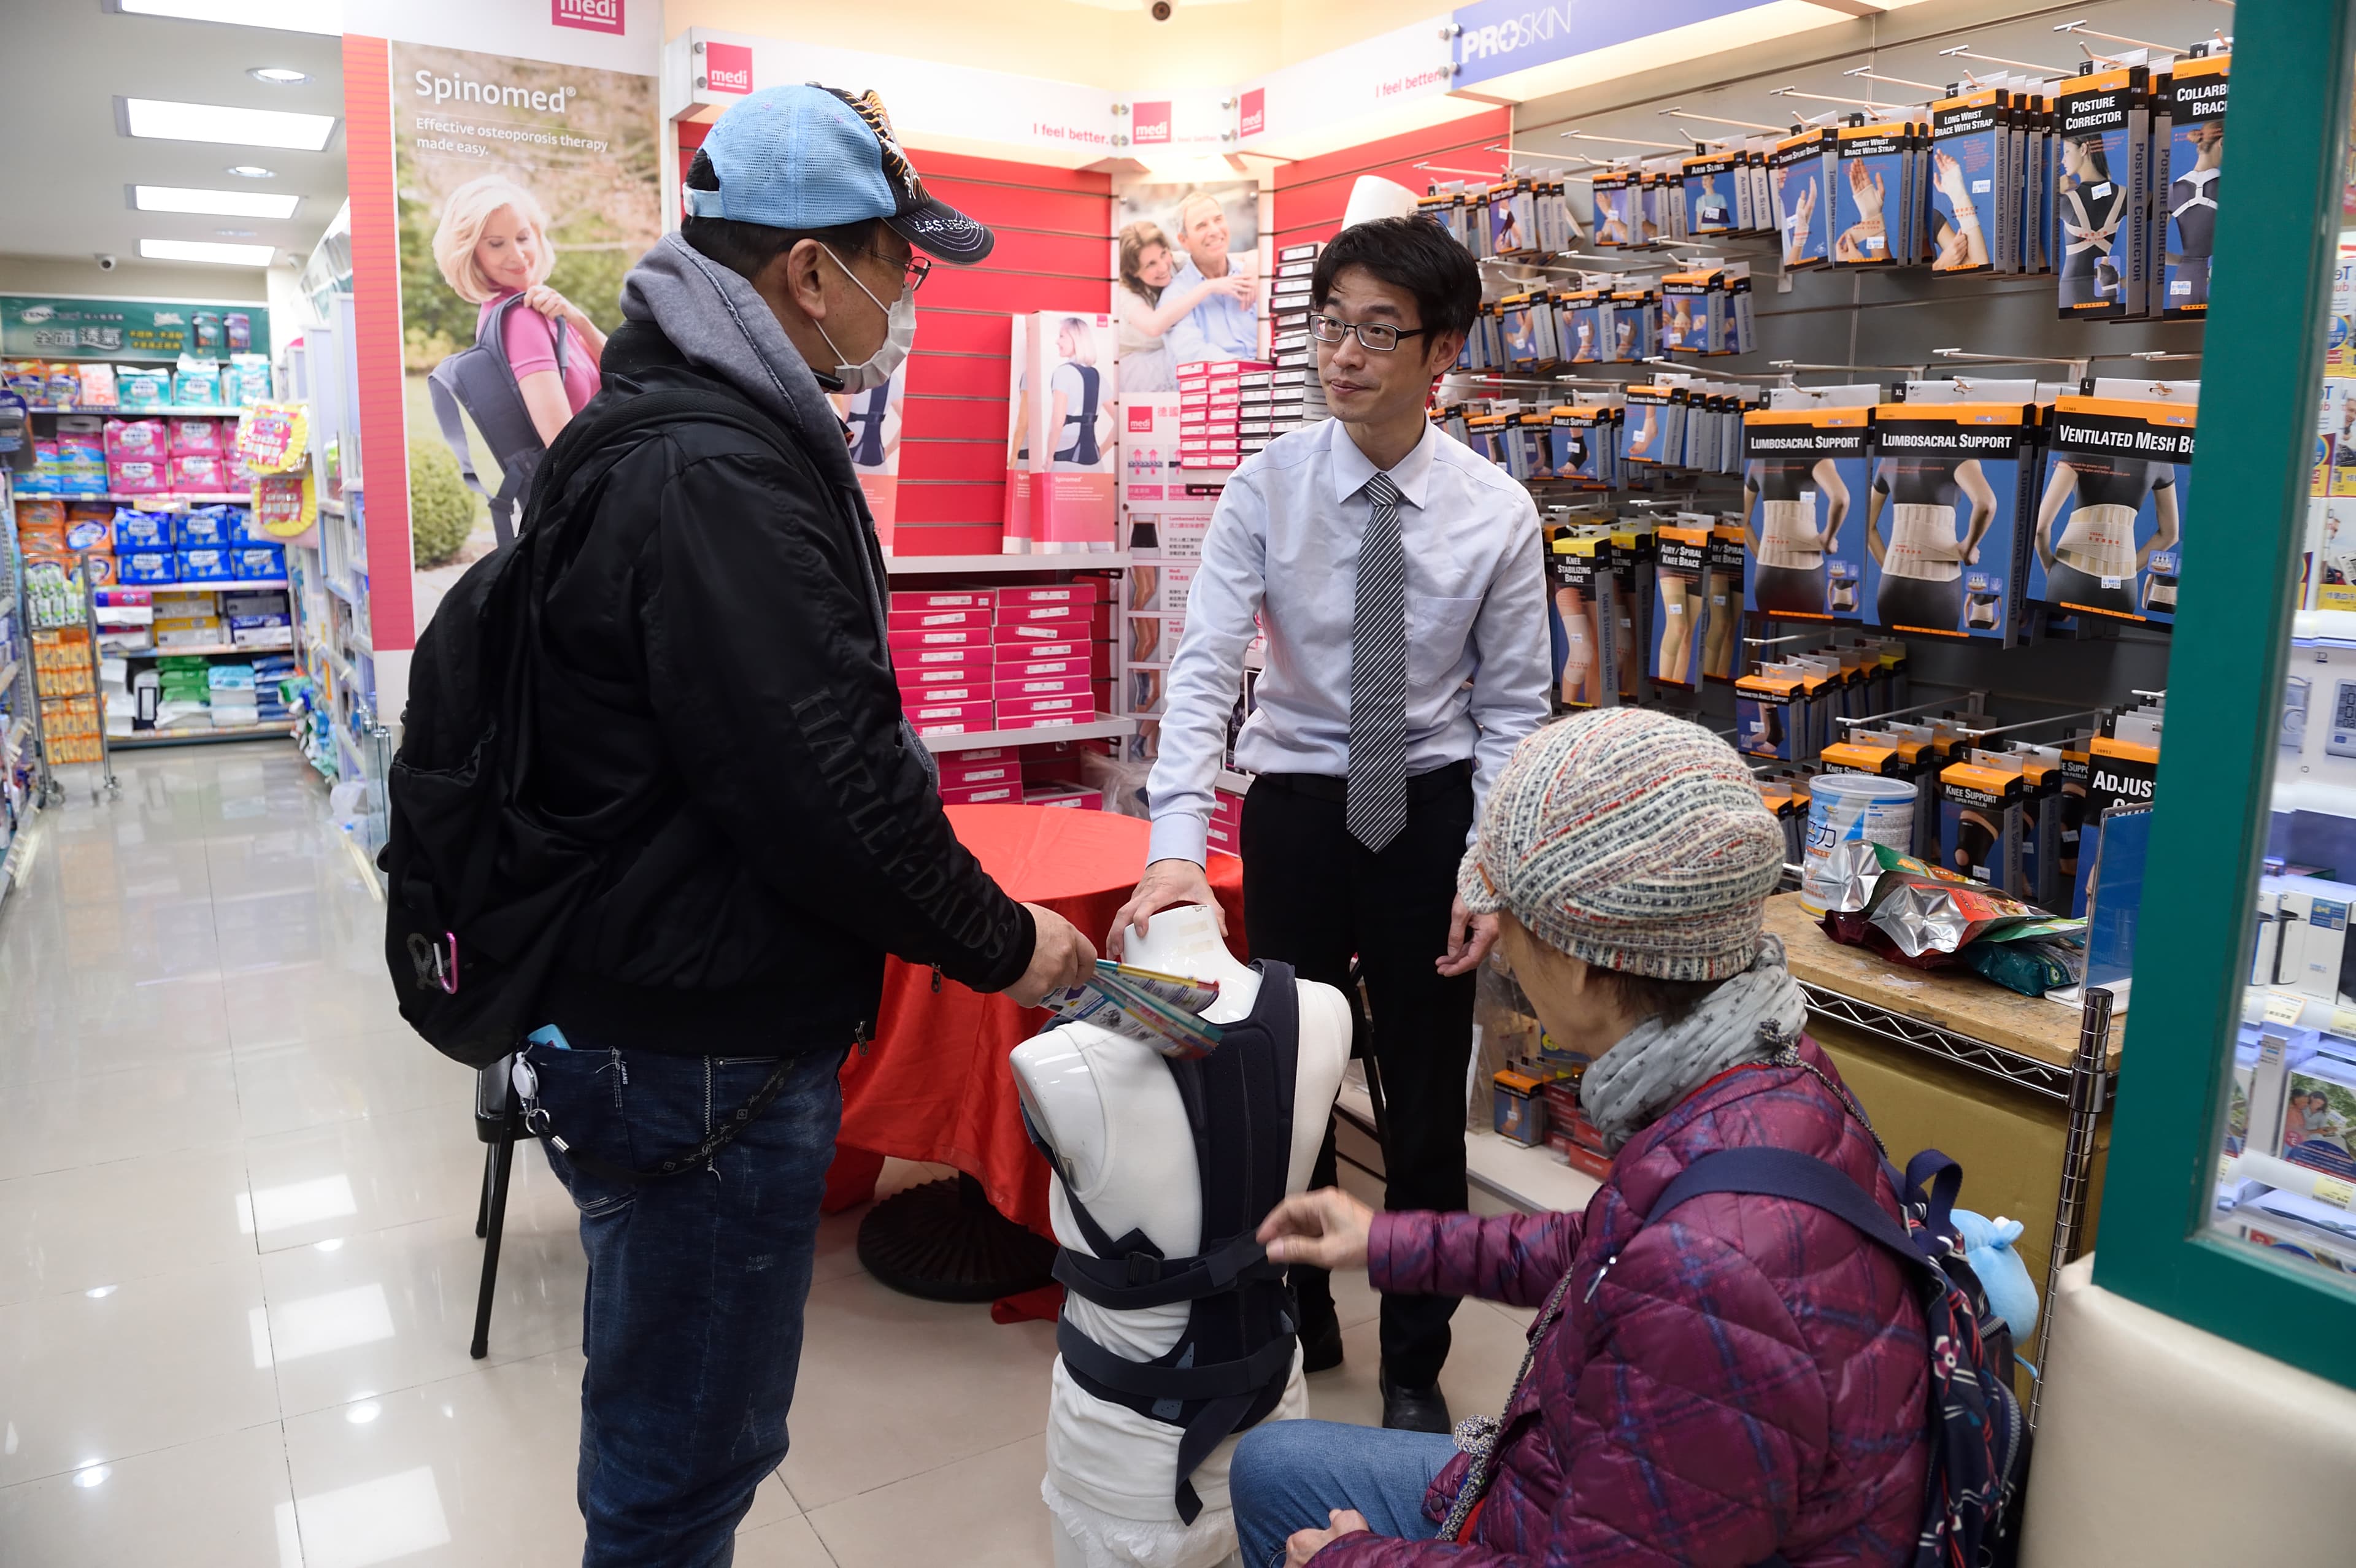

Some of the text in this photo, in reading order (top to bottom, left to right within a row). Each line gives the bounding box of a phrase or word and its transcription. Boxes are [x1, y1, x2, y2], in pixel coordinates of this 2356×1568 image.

[560, 0, 617, 18] medi
[1461, 1, 1572, 64] PROSKIN
[711, 69, 748, 85] medi
[1382, 79, 1402, 96] feel
[2071, 96, 2115, 114] POSTURE
[1241, 109, 1263, 129] medi
[1944, 110, 1983, 125] LONG WRIST
[2066, 110, 2122, 130] CORRECTOR
[417, 117, 608, 153] Effective osteoporosis therapy
[1041, 125, 1064, 139] feel
[1068, 129, 1110, 145] better.
[1135, 122, 1167, 137] medi
[1934, 119, 1993, 137] BRACE WITH STRAP
[417, 137, 489, 156] made easy.
[1852, 139, 1870, 148] SHORT
[1844, 148, 1862, 156] BRACE
[1691, 163, 1725, 175] ARM SLING
[2133, 143, 2144, 282] POSTURE CORRECTOR
[2157, 149, 2169, 285] POSTURE CORRECTOR
[915, 220, 944, 233] LAS
[1130, 418, 1151, 428] medi
[1553, 417, 1593, 427] ANKLE SUPPORT
[1750, 436, 1860, 450] LUMBOSACRAL SUPPORT
[1882, 432, 2012, 448] LUMBOSACRAL SUPPORT
[2059, 425, 2133, 447] VENTILATED
[2135, 431, 2177, 452] MESH
[1566, 556, 1581, 565] KNEE
[1662, 554, 1701, 568] KNEE BRACE
[1722, 554, 1743, 565] BRACE
[1557, 564, 1592, 574] STABILIZING
[1565, 574, 1584, 583] BRACE
[1946, 785, 1998, 804] KNEE SUPPORT
